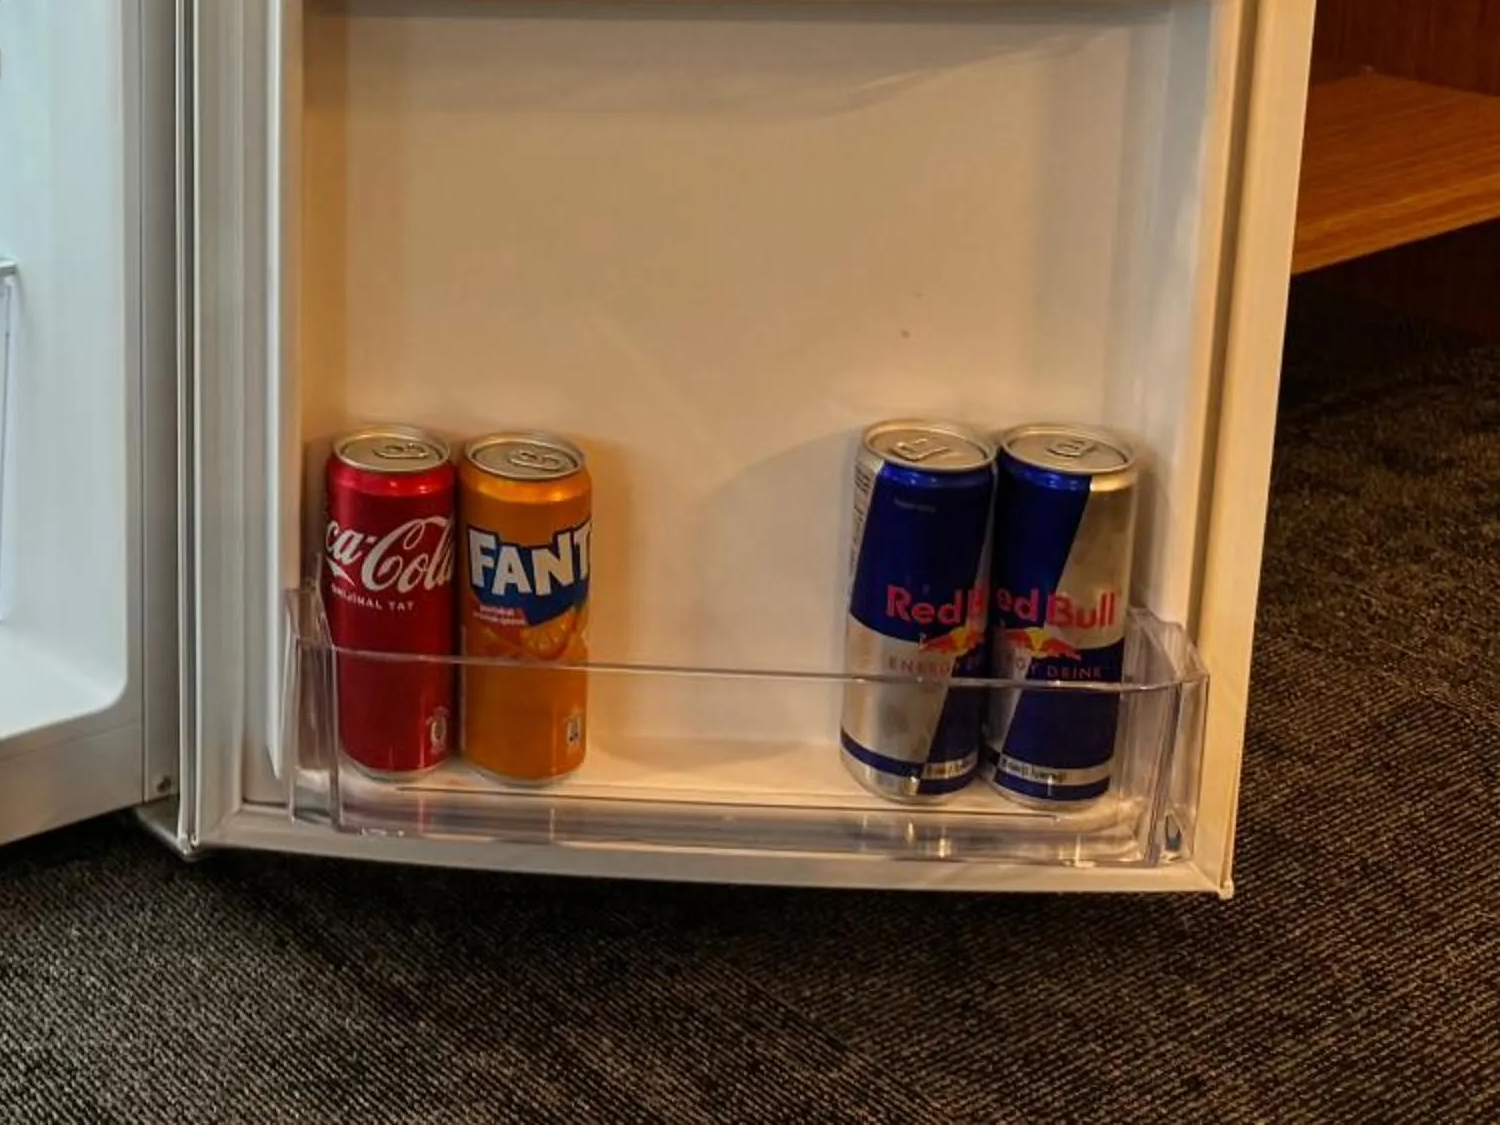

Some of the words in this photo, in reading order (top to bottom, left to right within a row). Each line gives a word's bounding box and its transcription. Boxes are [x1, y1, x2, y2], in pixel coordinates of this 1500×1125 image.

[468, 522, 590, 595] FANT
[886, 585, 963, 623] Red
[997, 587, 1039, 622] ed
[1047, 592, 1116, 630] Bull
